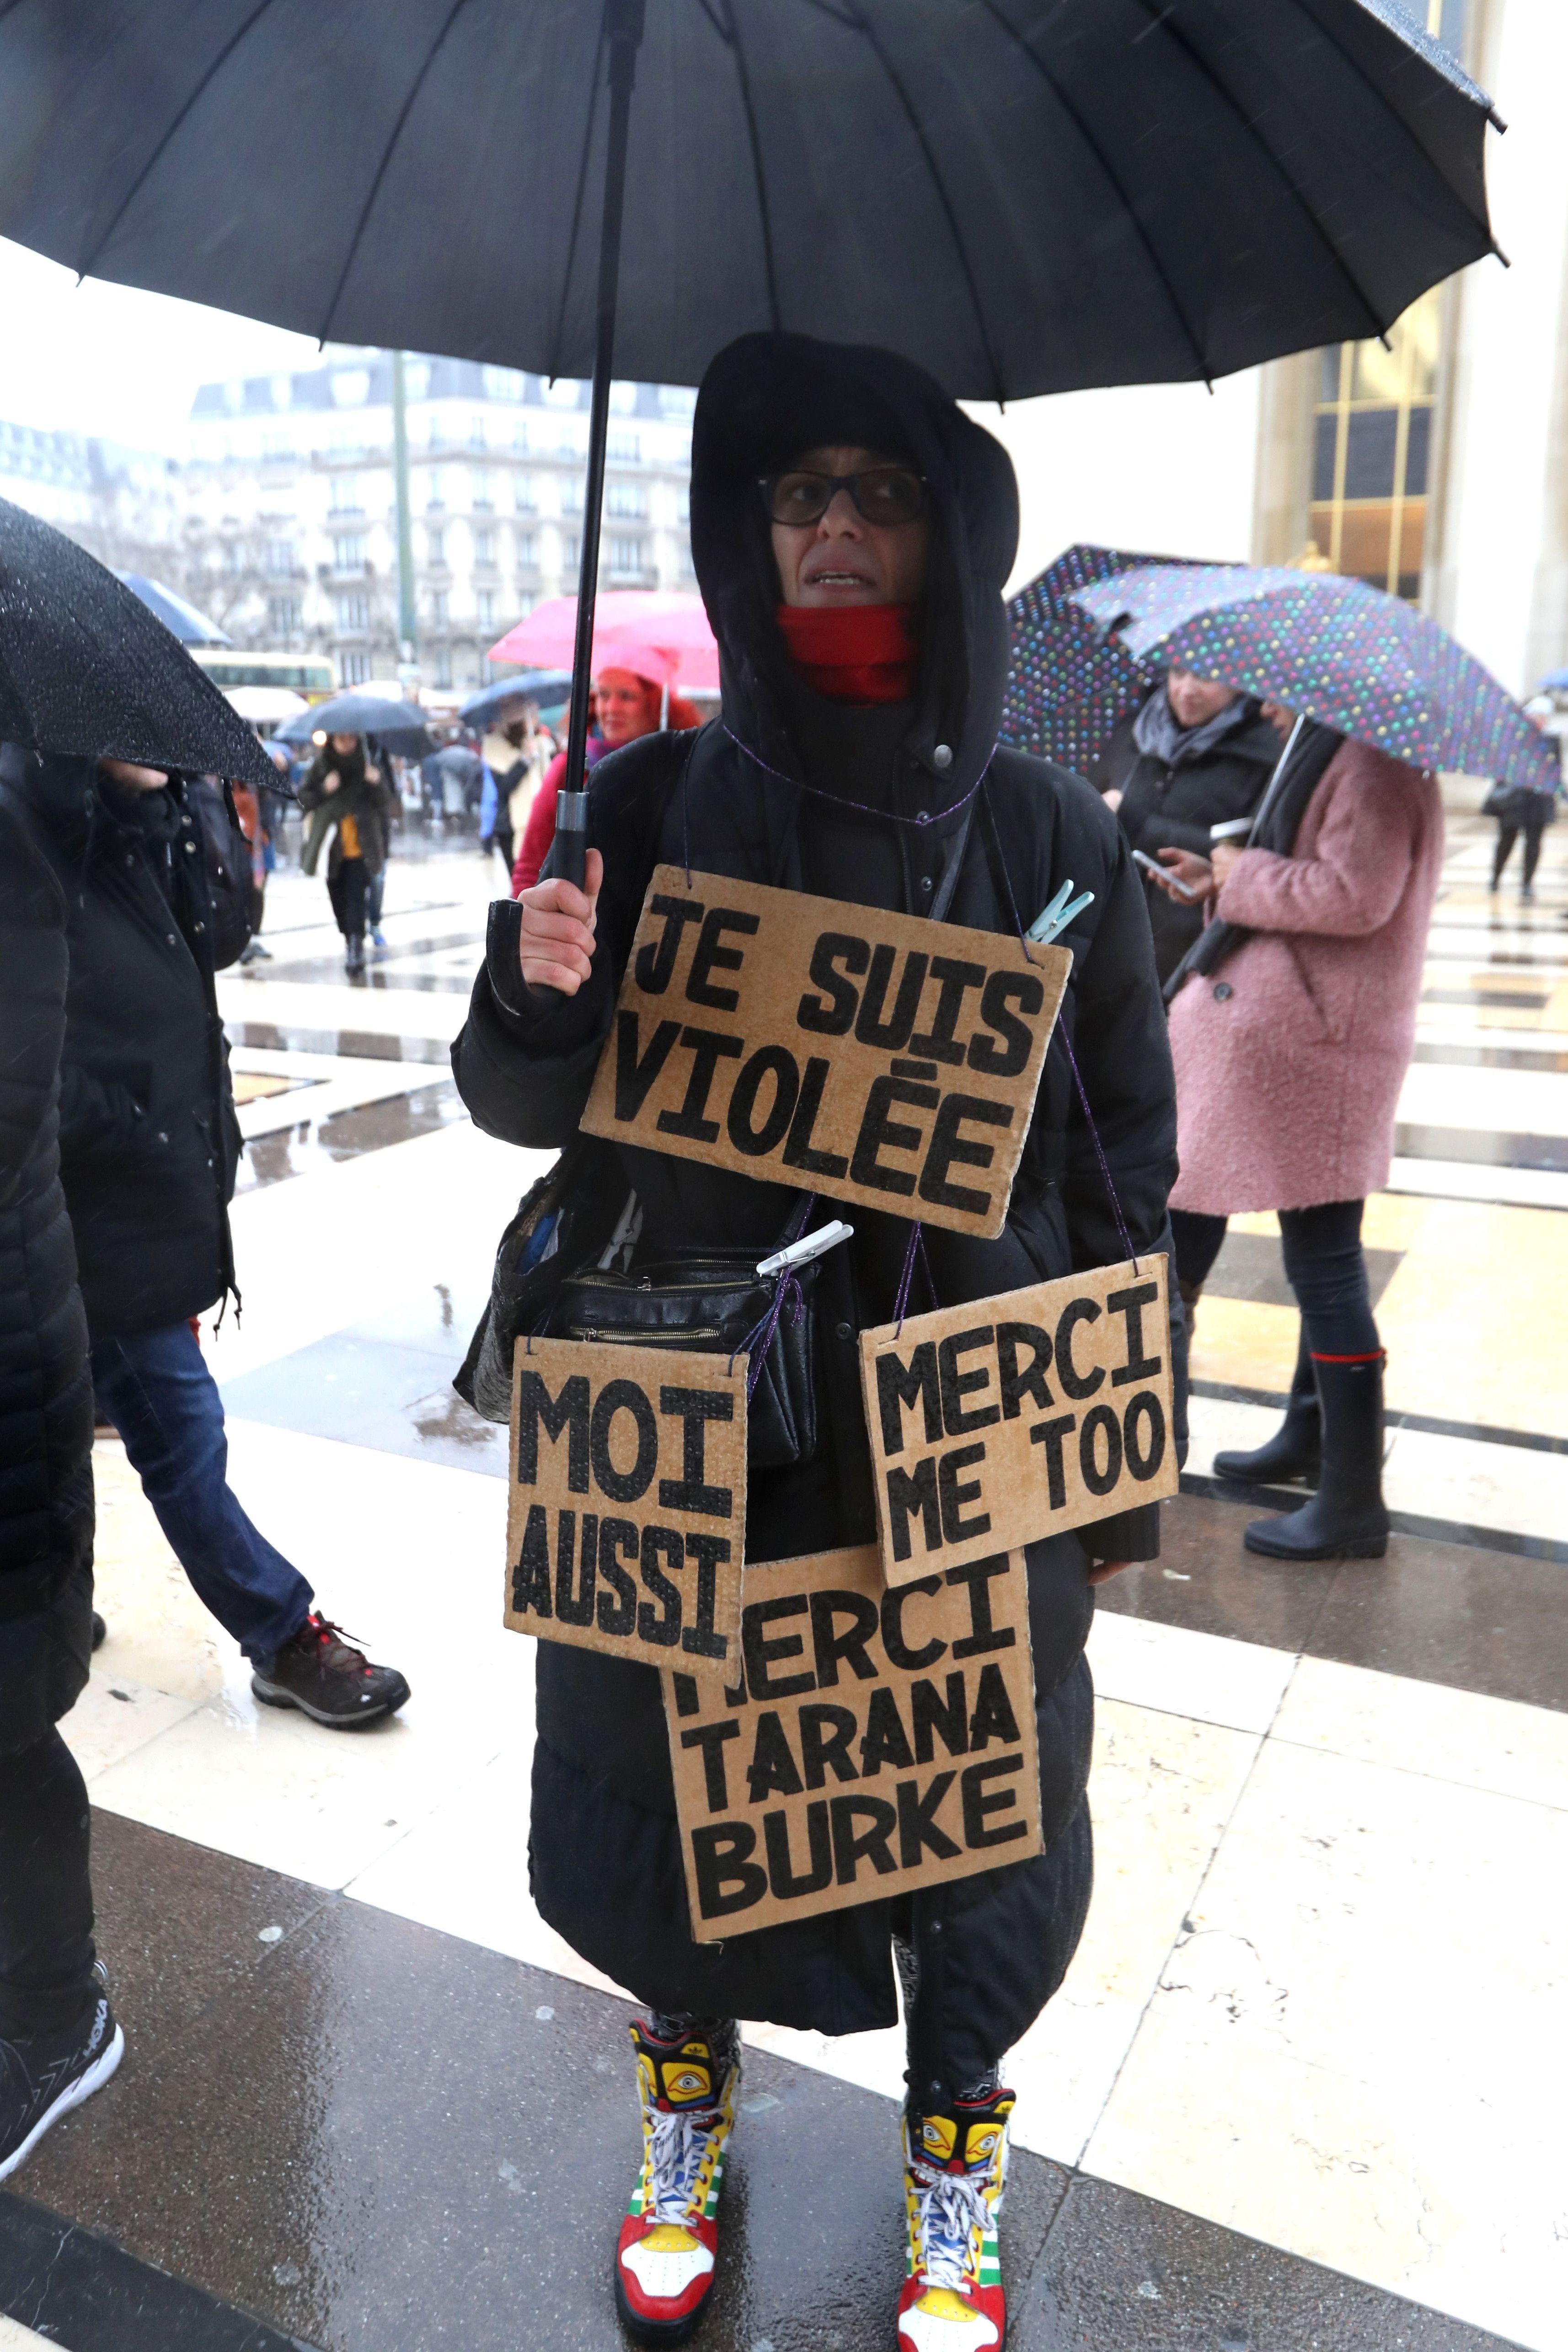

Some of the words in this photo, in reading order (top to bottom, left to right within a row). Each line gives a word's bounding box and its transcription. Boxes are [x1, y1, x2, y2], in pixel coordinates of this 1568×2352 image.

[636, 895, 759, 1012] JE
[797, 931, 1044, 1077] SUIS
[519, 1370, 733, 1518] MOI
[876, 1282, 1161, 1456] MERCI
[886, 1442, 991, 1562] ME
[1030, 1390, 1165, 1511] TOO
[512, 1504, 731, 1659] AUSSI
[673, 1552, 1016, 1717] ERCI
[681, 1664, 1021, 1813] TARANA
[691, 1753, 1028, 1919] BURKE
